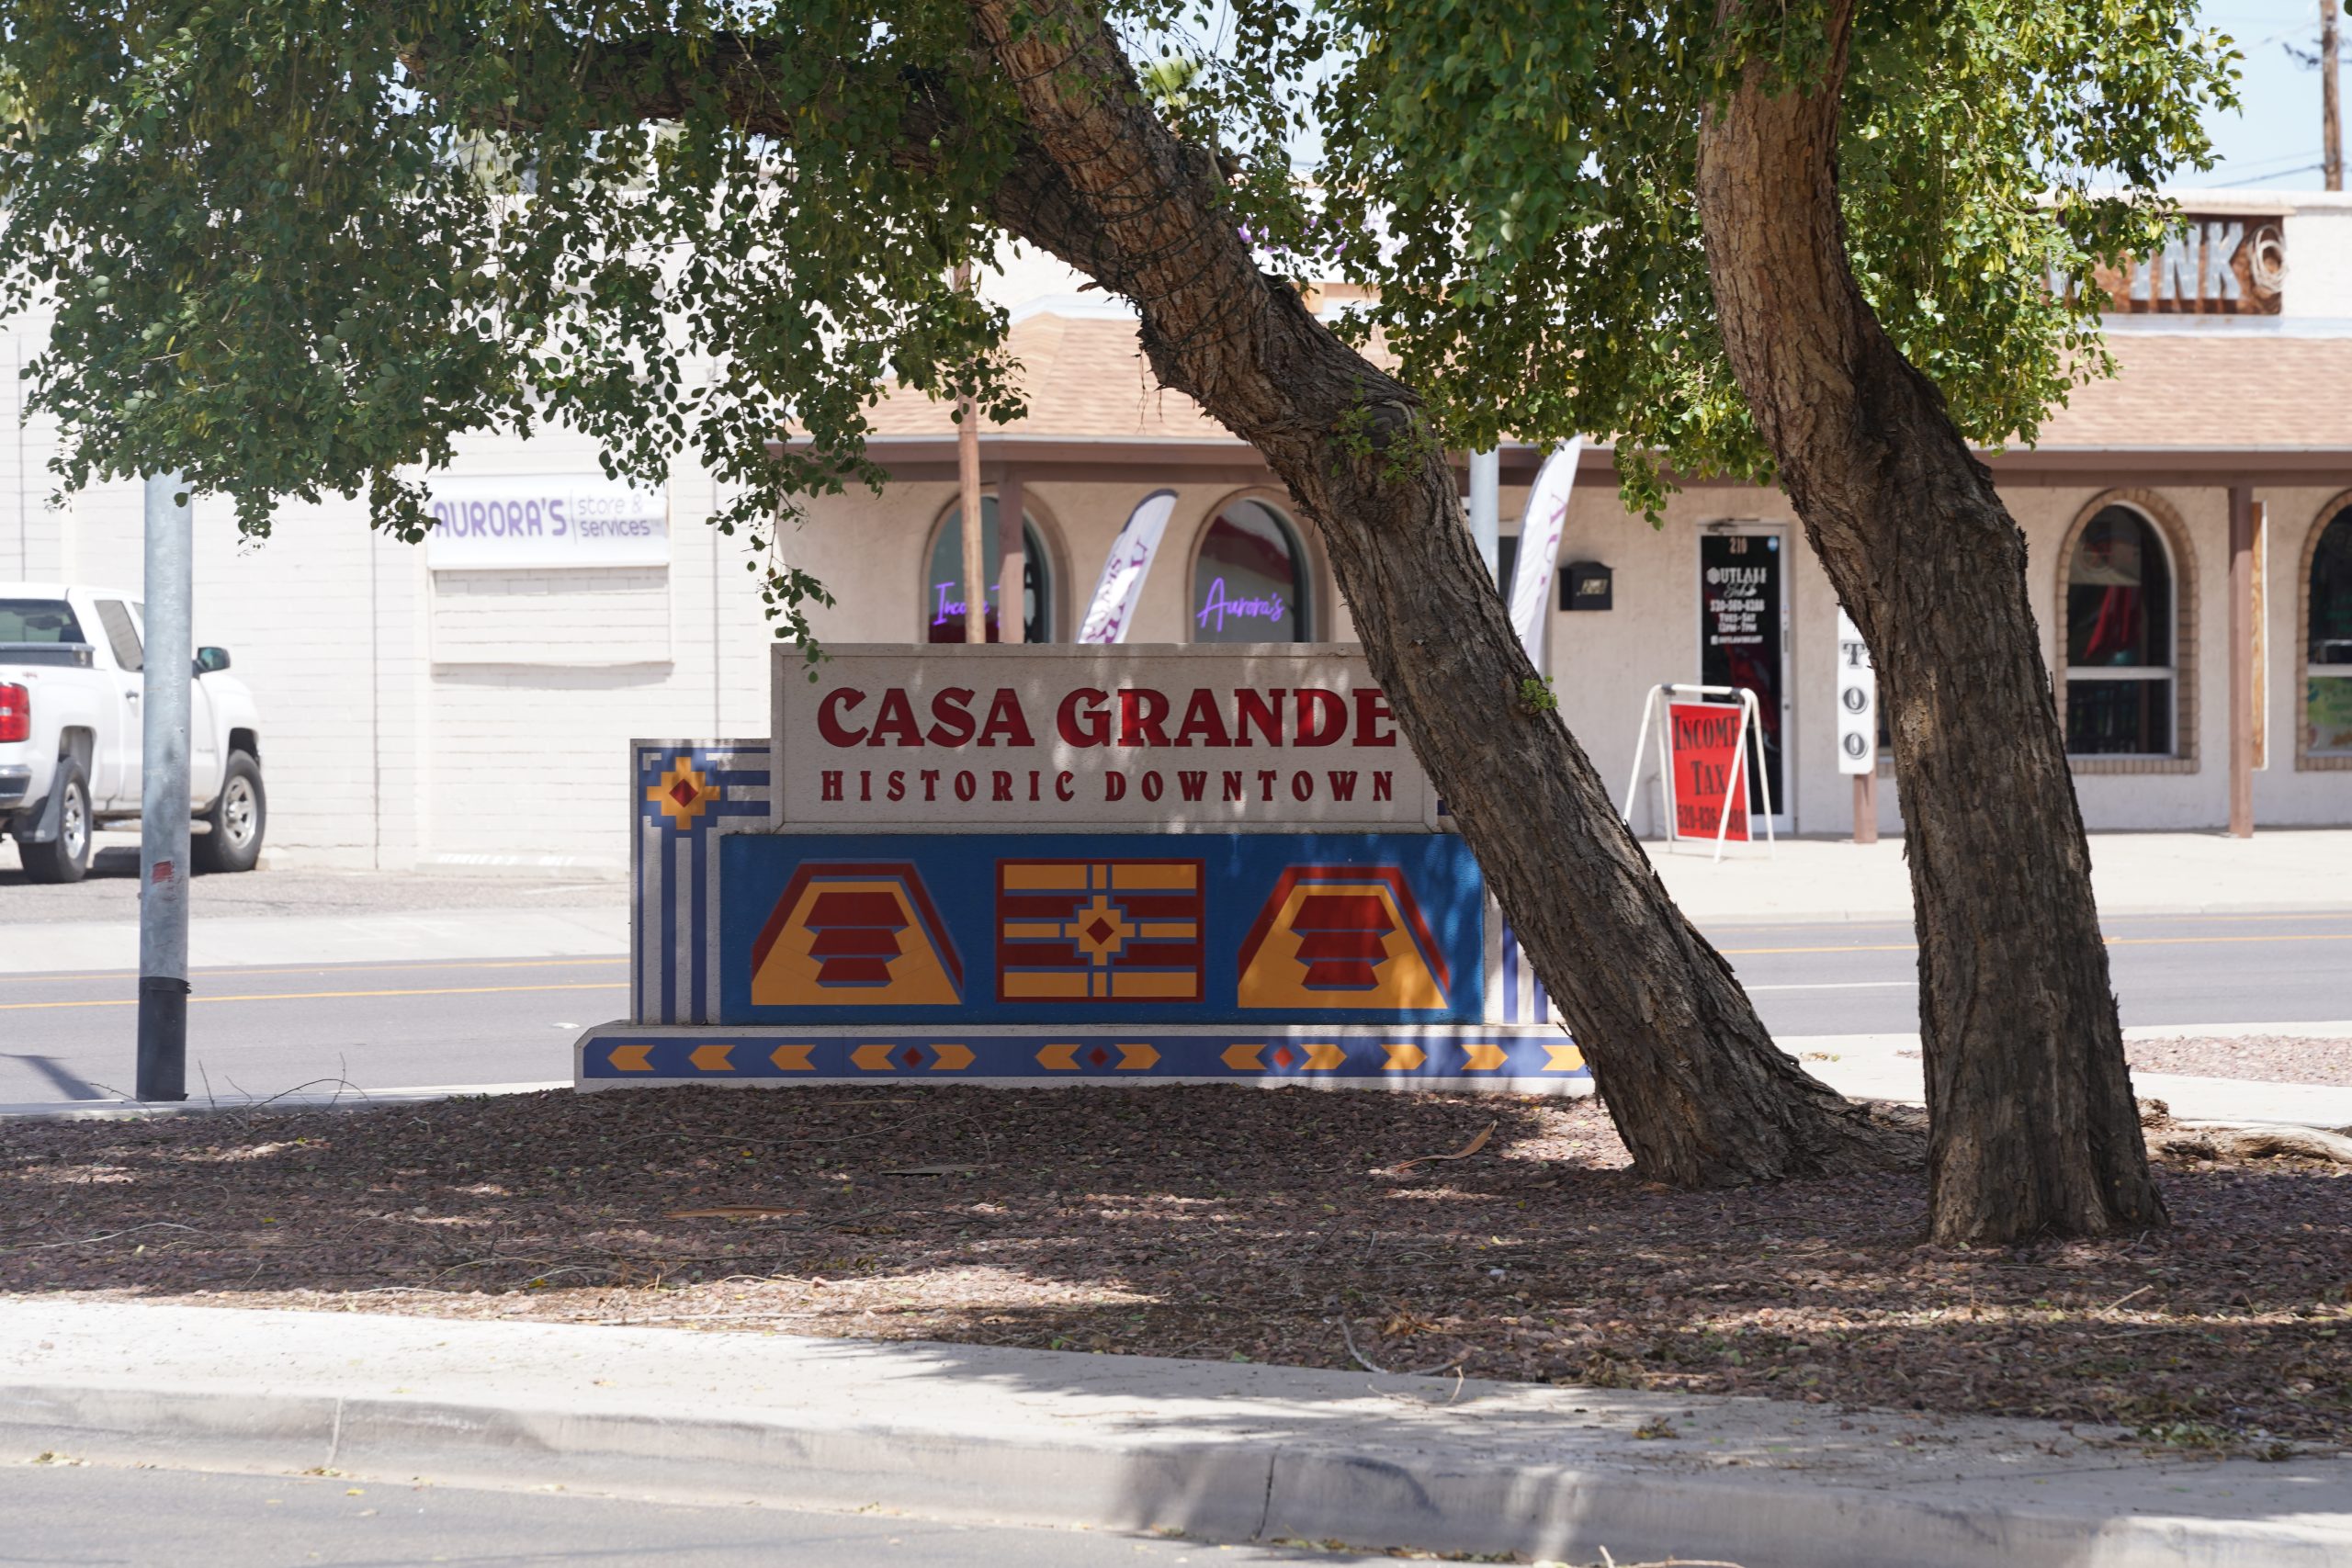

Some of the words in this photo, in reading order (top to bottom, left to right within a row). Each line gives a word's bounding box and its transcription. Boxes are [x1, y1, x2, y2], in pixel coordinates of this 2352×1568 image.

[434, 498, 568, 538] AURORA'S
[578, 496, 626, 515] store
[580, 516, 651, 537] services
[1729, 536, 1747, 554] 210
[1196, 576, 1285, 632] Aurora's
[818, 687, 1035, 748] CASA
[1057, 687, 1396, 748] GRANDE
[1674, 714, 1739, 750] INCOME
[821, 770, 1075, 802] HISTORIC
[1104, 770, 1393, 802] DOWNTOWN
[1690, 760, 1726, 796] TAX
